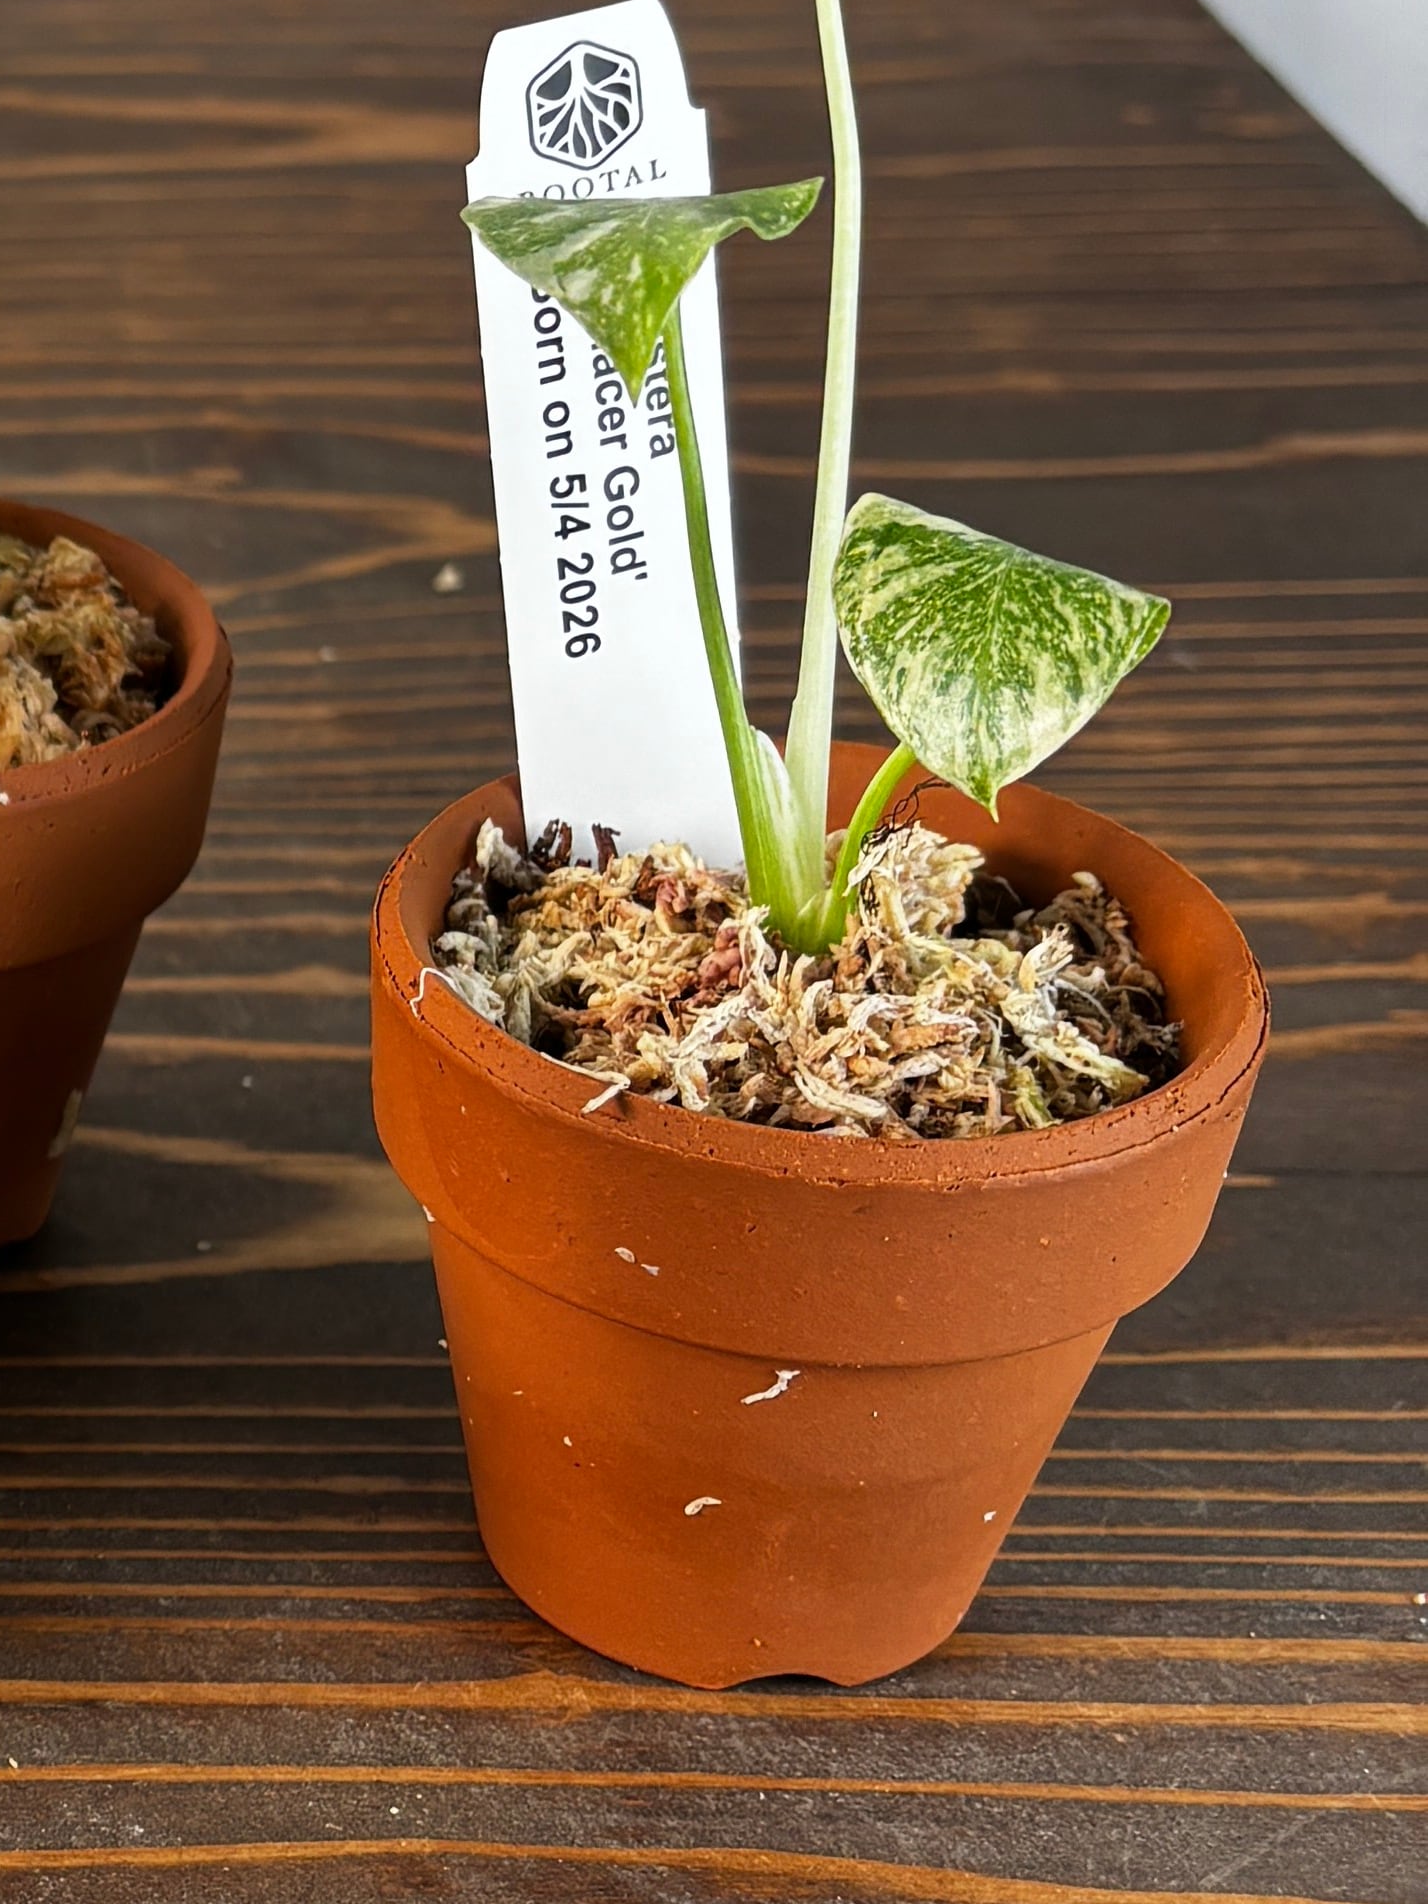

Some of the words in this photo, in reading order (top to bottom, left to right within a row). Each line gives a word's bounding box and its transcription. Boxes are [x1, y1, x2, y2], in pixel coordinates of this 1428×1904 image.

[543, 400, 573, 459] on
[591, 343, 628, 450] acer
[645, 341, 675, 459] stera
[549, 473, 591, 540] 5/4
[603, 465, 648, 581] Gold'
[557, 552, 601, 659] 2026
